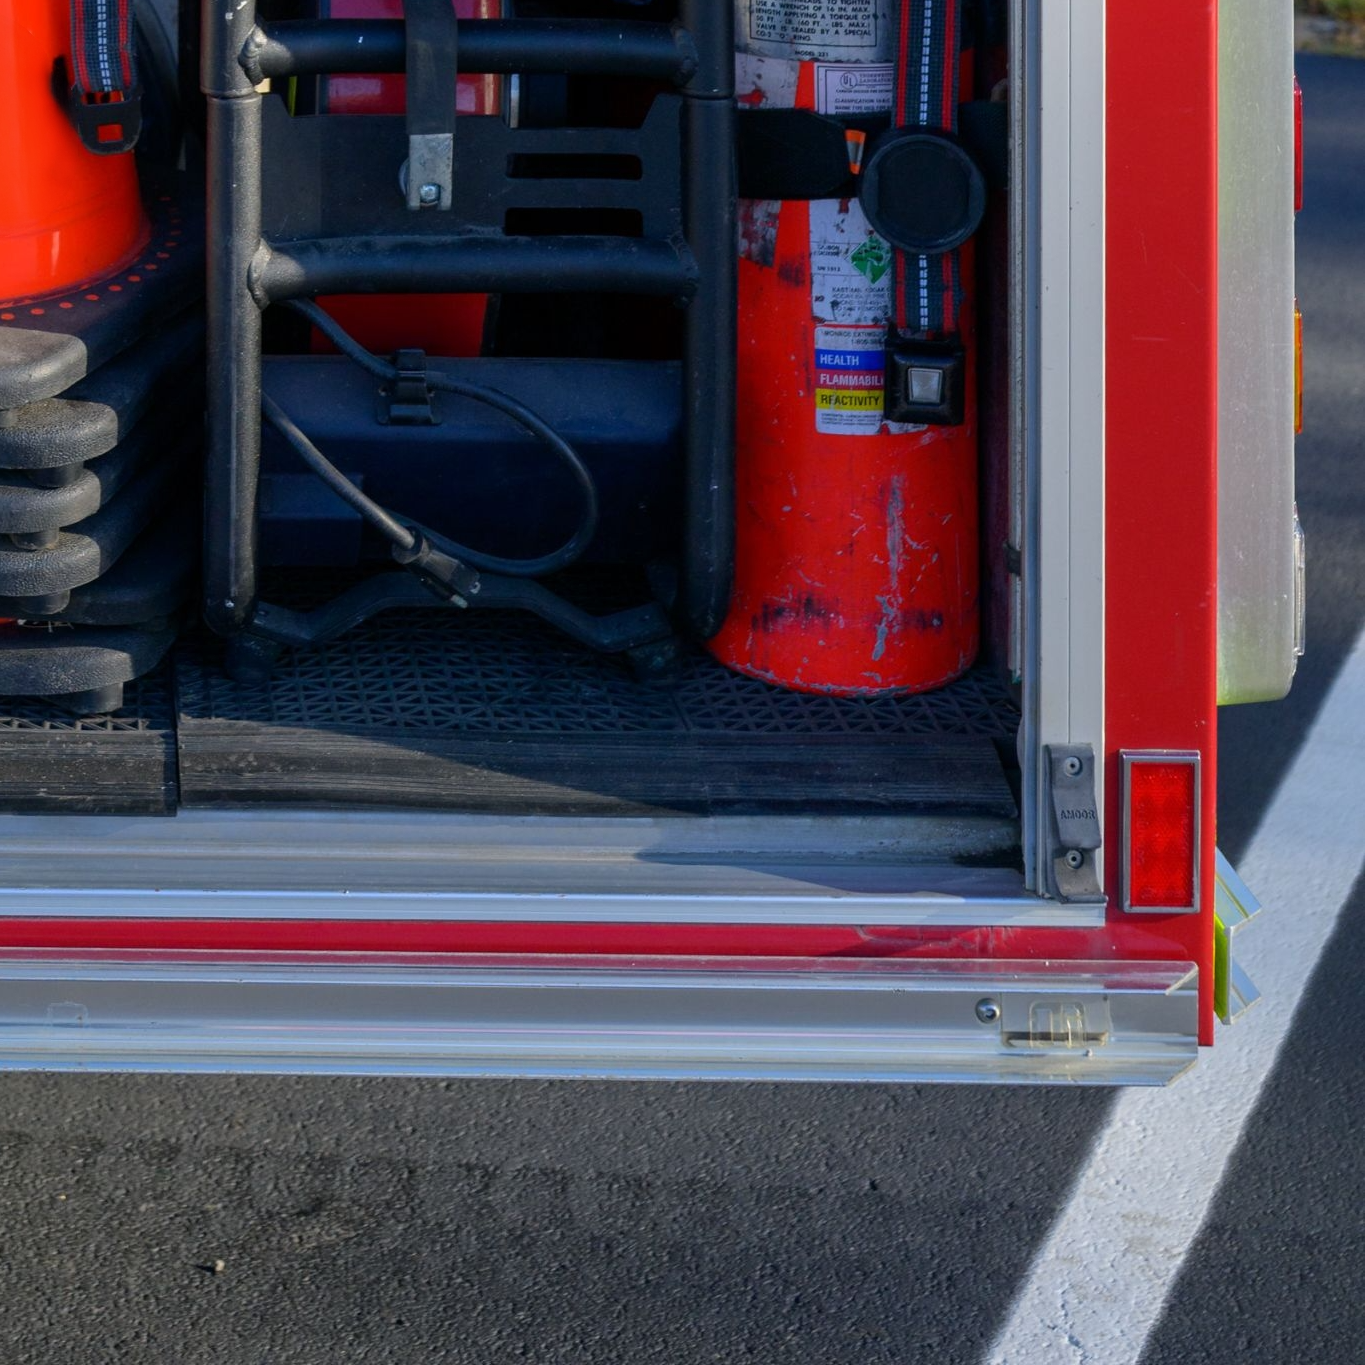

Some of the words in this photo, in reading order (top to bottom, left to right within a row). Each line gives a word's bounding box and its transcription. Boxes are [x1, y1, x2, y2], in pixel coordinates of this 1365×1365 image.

[780, 3, 809, 11] WRENCH
[756, 8, 780, 16] LENGTH
[784, 11, 817, 19] APPLYING
[843, 75, 853, 87] UL
[820, 354, 859, 366] HEALTH
[820, 374, 884, 386] FLAMMABIL
[821, 394, 880, 405] REACTIVITY
[1061, 809, 1096, 820] AMDOR
